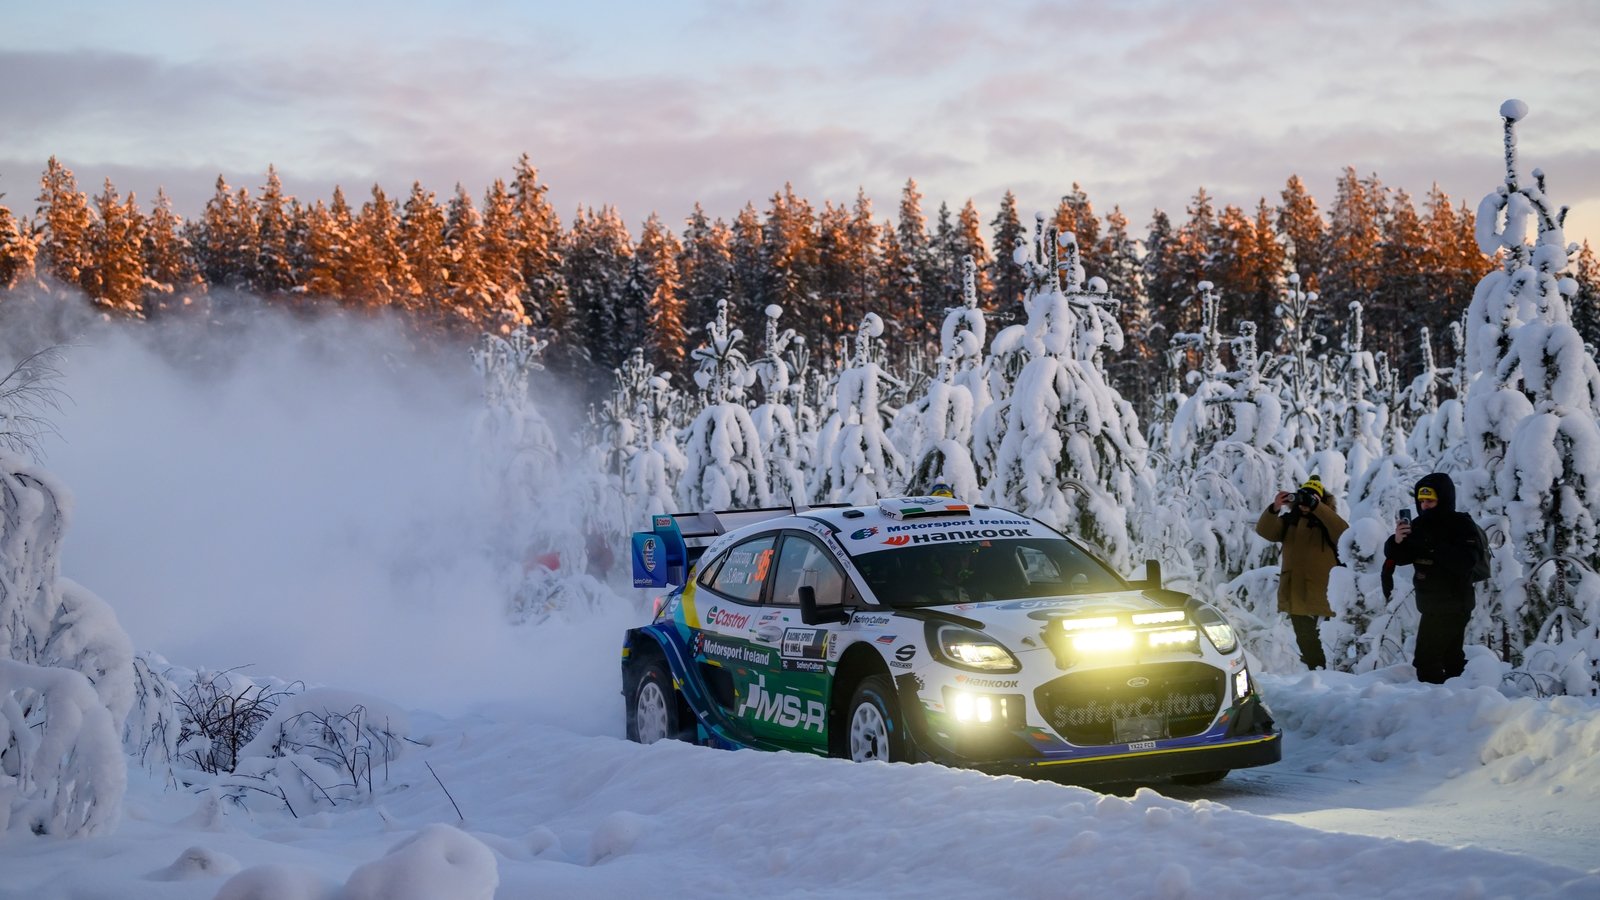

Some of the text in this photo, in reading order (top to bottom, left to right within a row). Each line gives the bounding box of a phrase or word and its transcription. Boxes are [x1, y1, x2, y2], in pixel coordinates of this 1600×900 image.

[887, 518, 1031, 533] Motorsport Ireland
[715, 609, 750, 629] Castrol
[852, 615, 890, 626] SafetyCulture
[786, 632, 801, 641] RACING
[703, 639, 742, 659] Motorsport
[742, 647, 770, 665] Ireland
[796, 661, 824, 671] SafetyCulture
[1055, 693, 1216, 728] SafetyCulture
